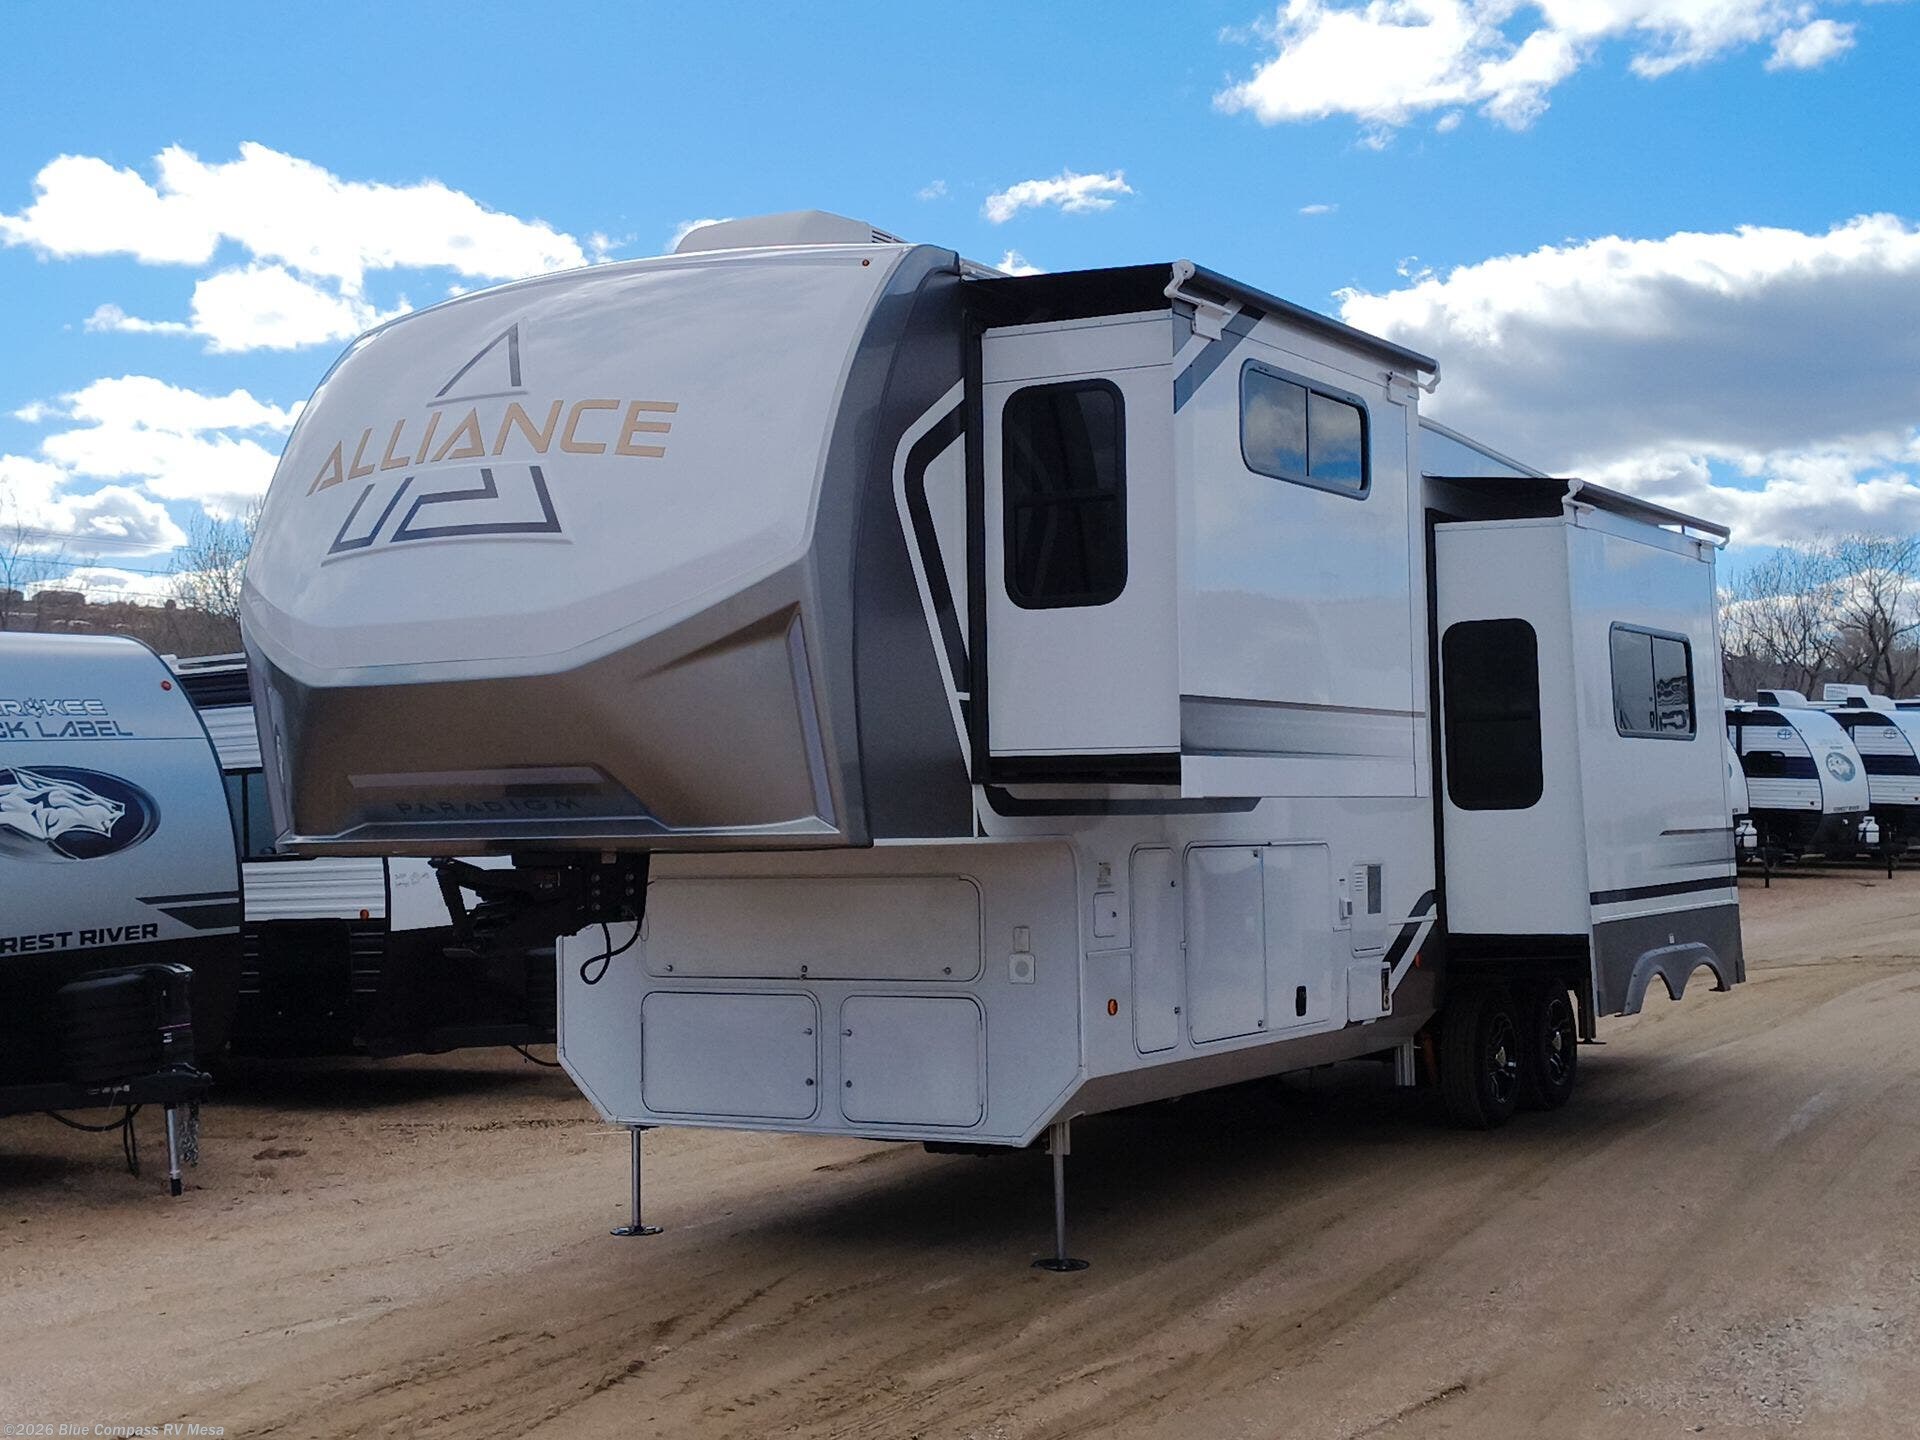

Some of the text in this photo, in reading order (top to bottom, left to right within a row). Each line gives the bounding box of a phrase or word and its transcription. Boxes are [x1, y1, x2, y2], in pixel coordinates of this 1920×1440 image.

[306, 399, 679, 497] ALLIANCE
[35, 720, 133, 737] LABEL
[0, 923, 158, 953] REST RIVER
